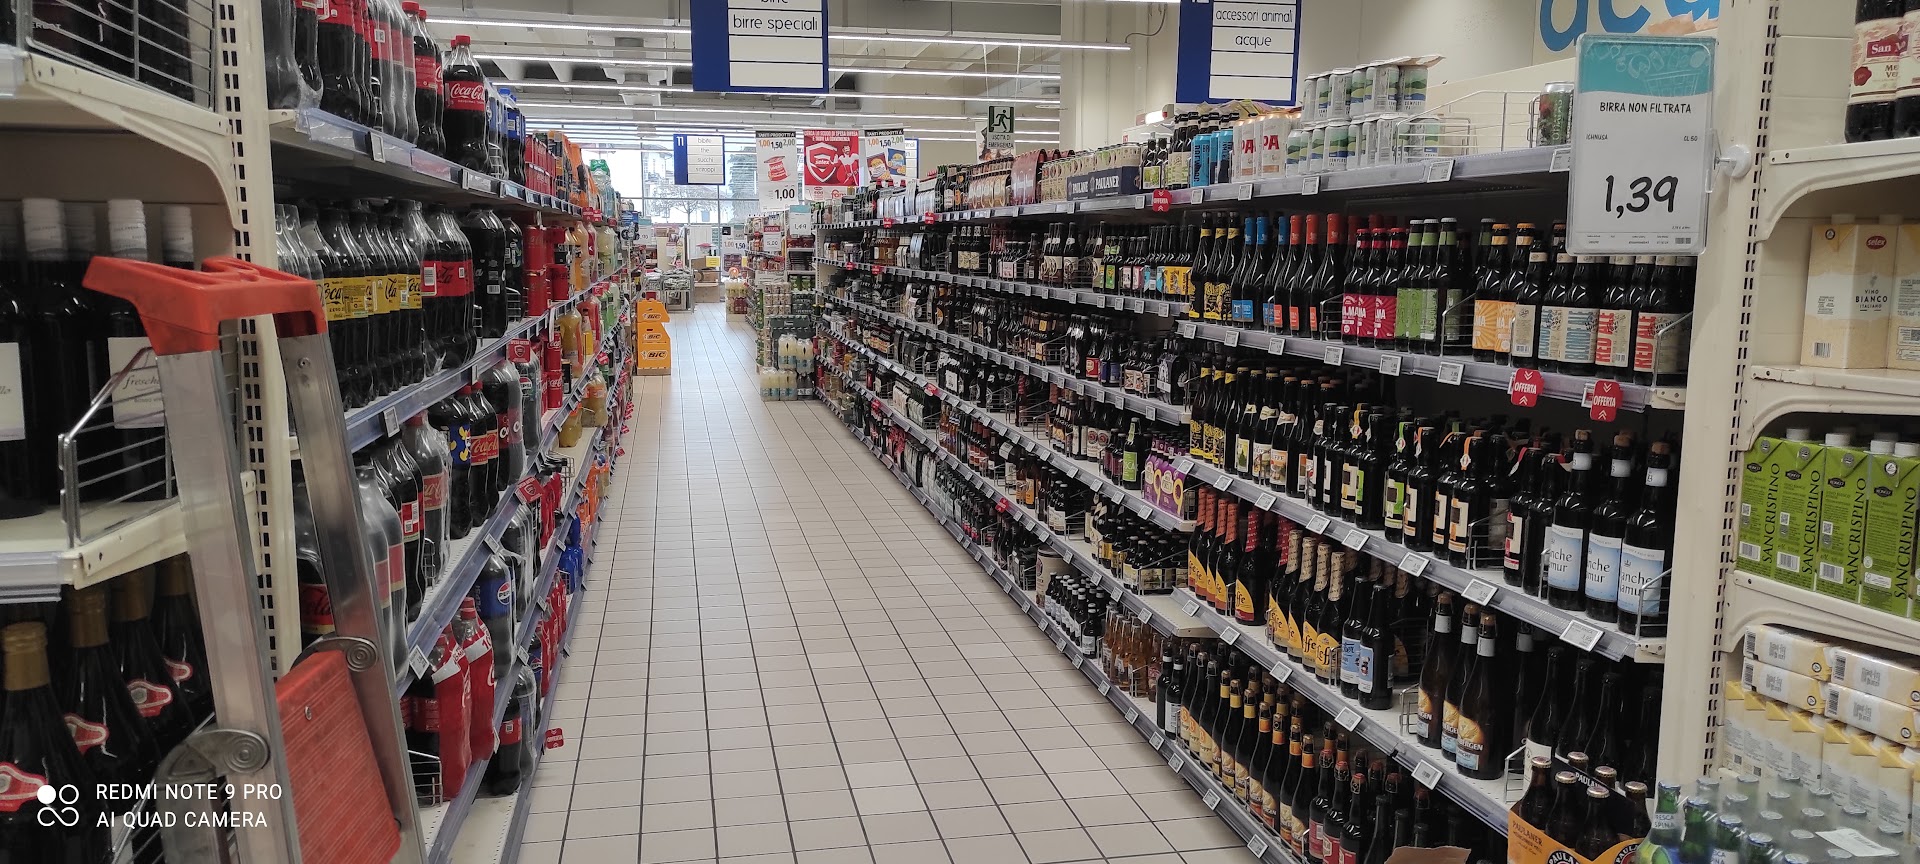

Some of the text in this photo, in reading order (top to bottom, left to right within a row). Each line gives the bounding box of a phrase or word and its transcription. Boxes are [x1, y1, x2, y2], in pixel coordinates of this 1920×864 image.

[1215, 9, 1259, 21] accessori
[733, 14, 818, 33] birre speciali
[1235, 35, 1272, 49] acque
[1871, 44, 1891, 55] San
[1600, 102, 1691, 113] BIRRA NON FILTRATA
[676, 136, 684, 146] 11
[771, 141, 782, 150] 1,50
[783, 138, 795, 146] 2,00
[868, 136, 903, 148] 1,00 1,50 2,00
[1095, 175, 1119, 190] PAULANER
[774, 188, 795, 201] 1,00
[1605, 175, 1679, 219] 1,39
[1867, 238, 1886, 246] selex
[1855, 295, 1888, 303] BIANCO
[1595, 312, 1615, 363] RED ALE
[1634, 316, 1657, 369] RED ALE
[1514, 382, 1537, 394] OFFERTA
[1593, 395, 1616, 407] OFFERTA
[1762, 463, 1780, 563] SANCRISPINO
[1801, 470, 1820, 574] SANCRISPINO
[1847, 478, 1866, 586] SANCRISPINO
[1894, 487, 1916, 599] SANCRISPINO
[1512, 820, 1543, 847] PAULANER
